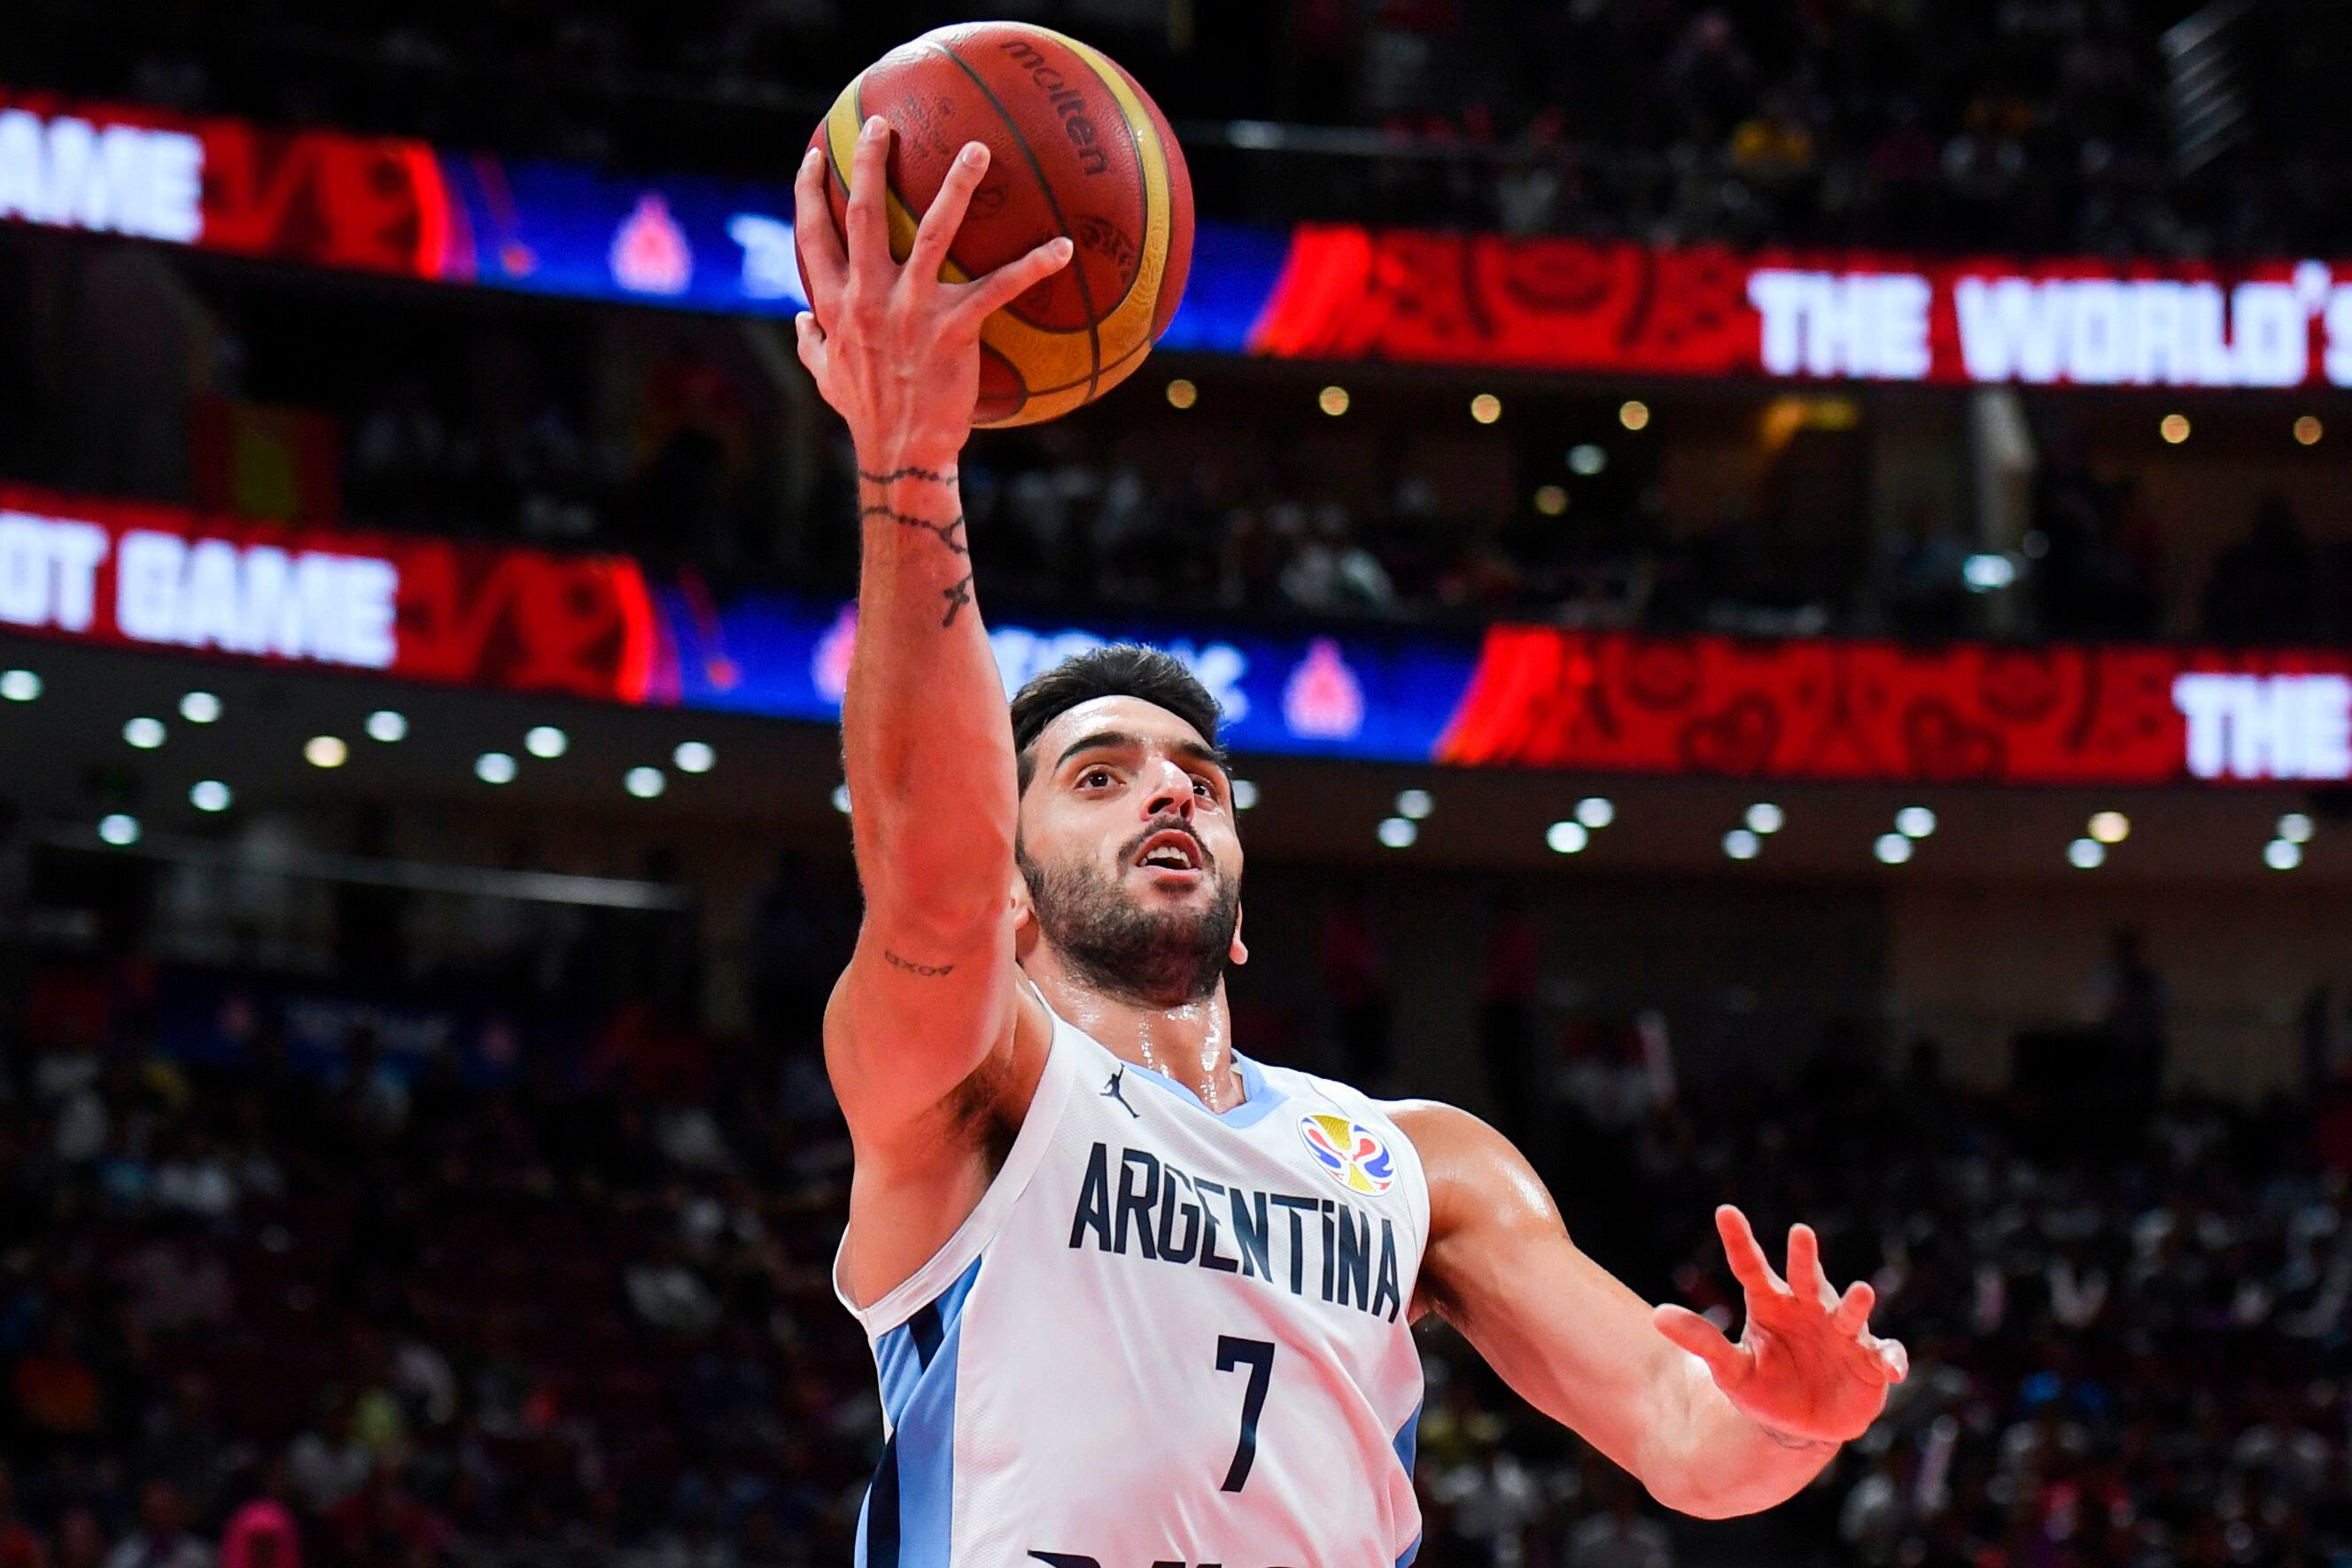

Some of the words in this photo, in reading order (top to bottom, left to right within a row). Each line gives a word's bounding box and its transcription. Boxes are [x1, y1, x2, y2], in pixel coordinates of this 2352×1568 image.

[999, 41, 1108, 176] molten
[1747, 268, 1931, 379] THE
[117, 531, 397, 668] GAME
[2172, 673, 2352, 780] THE
[1068, 1141, 1401, 1323] ARGENTINA
[1215, 1334, 1276, 1493] 7
